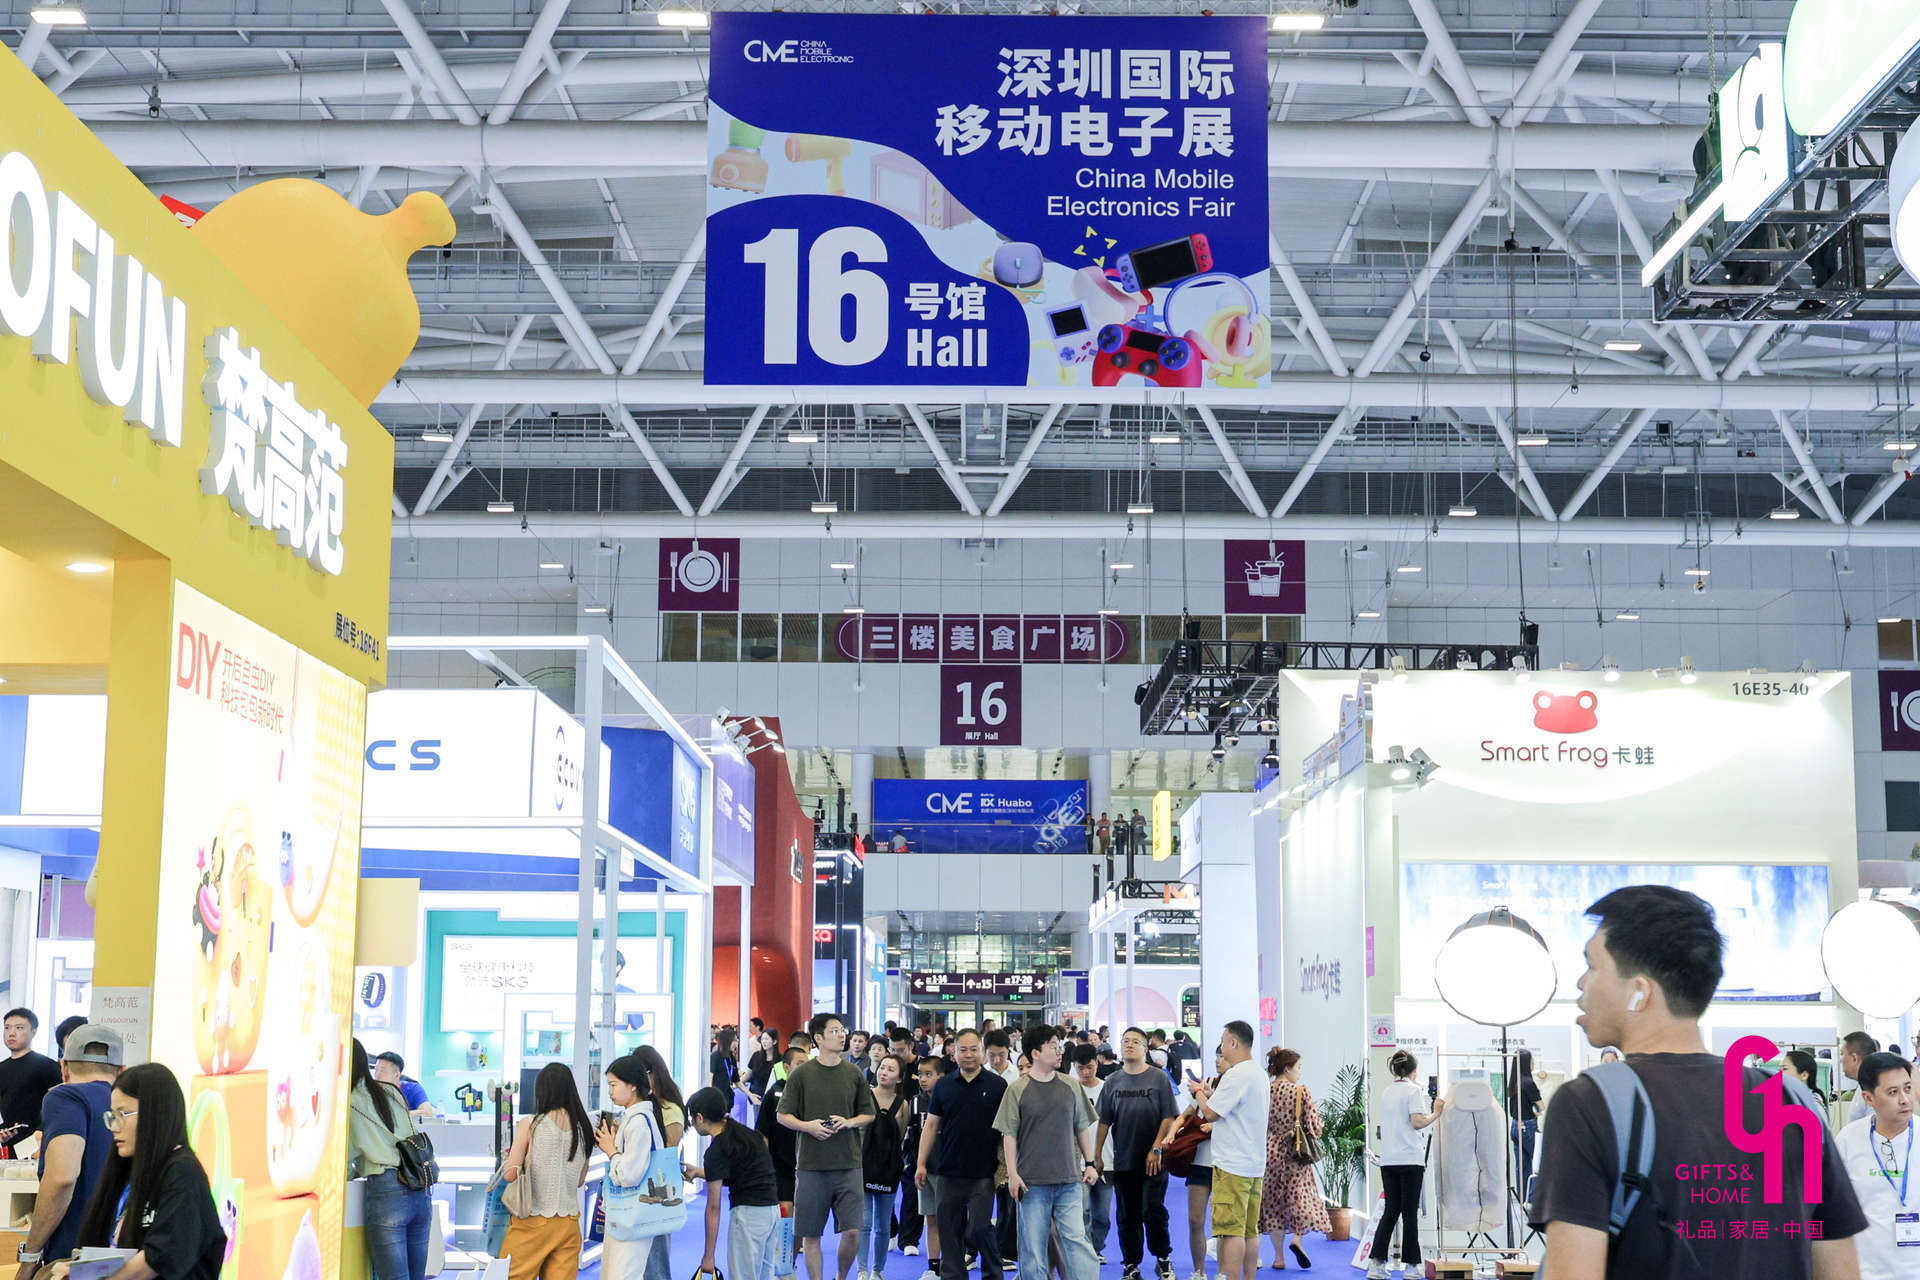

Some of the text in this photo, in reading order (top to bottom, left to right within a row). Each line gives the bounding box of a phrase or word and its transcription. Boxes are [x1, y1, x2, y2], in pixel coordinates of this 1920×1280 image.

[743, 39, 799, 63] CME
[800, 40, 827, 48] CHINA
[800, 55, 854, 63] ELECTRONIC
[997, 47, 1235, 100] 深圳国际
[935, 104, 1235, 158] 移动电子展
[1075, 167, 1234, 188] China Mobile
[1047, 196, 1235, 217] Electronics Fair
[743, 226, 889, 366] 16
[904, 282, 987, 321] 号馆
[906, 328, 988, 367] Hall
[870, 625, 1096, 651] 三楼美食广场
[177, 622, 221, 700] DIY
[956, 681, 1008, 726] 16
[984, 732, 999, 741] Hall
[1481, 740, 1549, 762] Smart
[1612, 745, 1655, 766] 卡蛙
[926, 792, 973, 814] CME
[997, 798, 1033, 808] Huabo
[981, 979, 992, 989] 15
[865, 1182, 892, 1192] adidas
